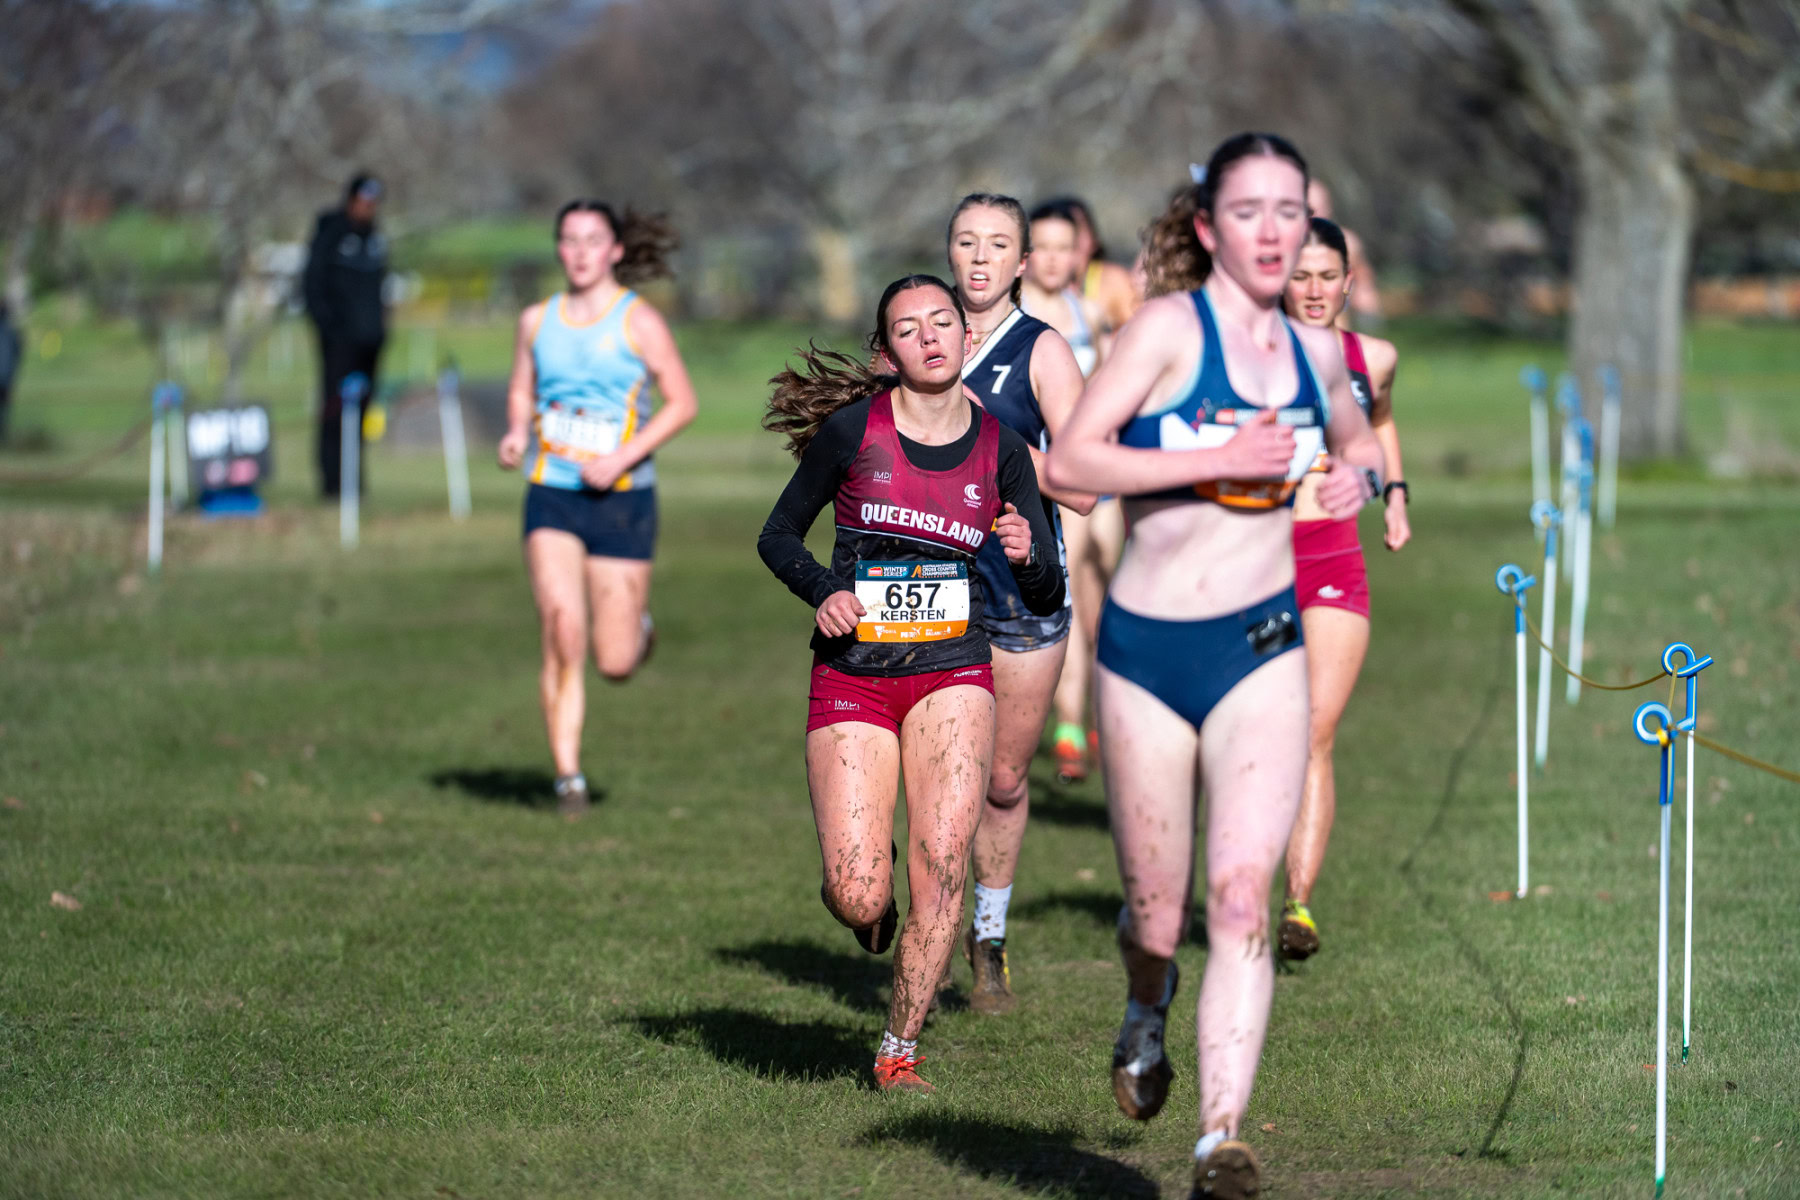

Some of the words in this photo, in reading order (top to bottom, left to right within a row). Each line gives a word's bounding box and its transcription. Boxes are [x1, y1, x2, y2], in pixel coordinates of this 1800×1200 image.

[991, 365, 1012, 394] 7
[873, 470, 892, 481] IMPI
[861, 503, 984, 548] QUEENSLAND
[885, 583, 941, 609] 657
[880, 609, 945, 621] KERSTEN
